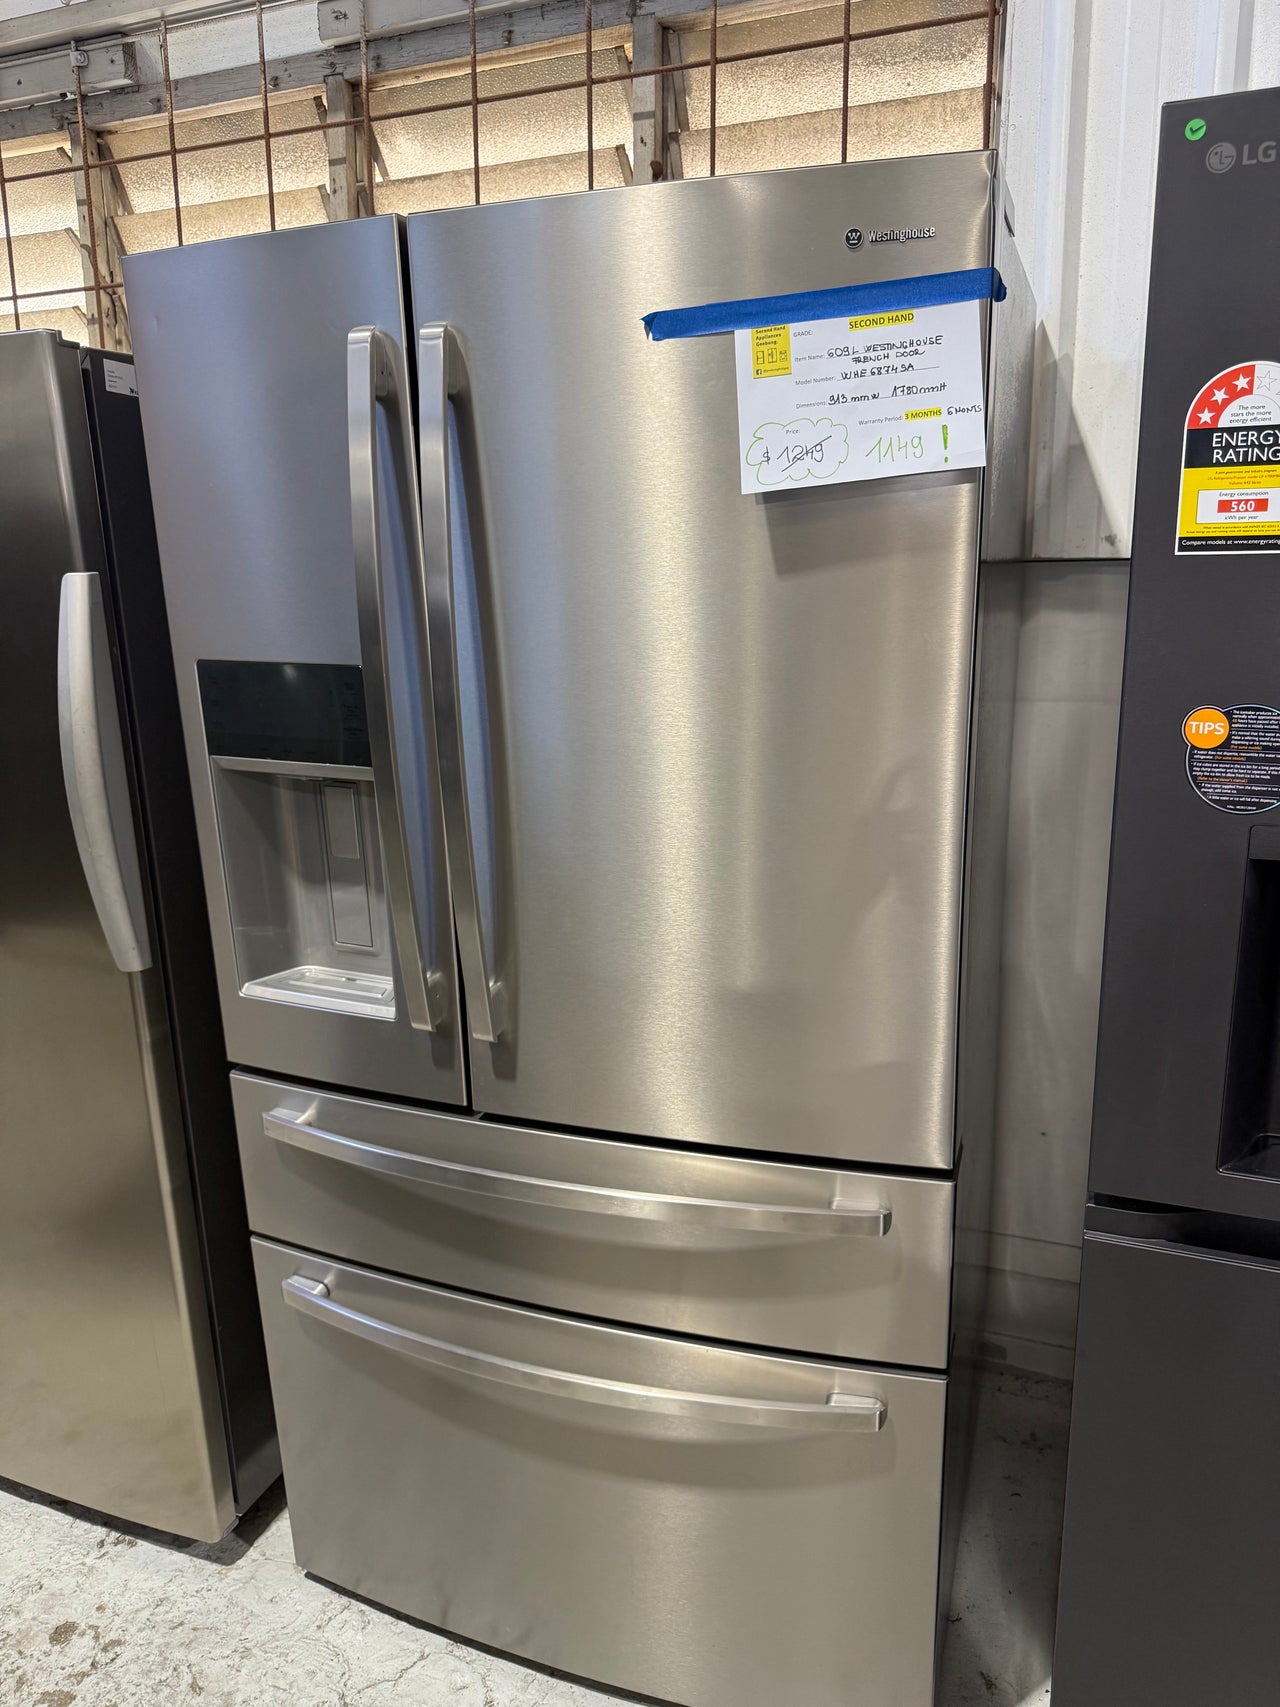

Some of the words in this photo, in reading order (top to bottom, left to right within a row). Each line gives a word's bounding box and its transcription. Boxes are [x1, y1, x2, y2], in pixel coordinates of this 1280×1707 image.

[1242, 141, 1277, 165] LG
[868, 227, 936, 242] Westinghouse
[849, 317, 885, 330] SECOND
[888, 312, 914, 324] HAND
[864, 335, 943, 352] WESTINGHOUSE
[896, 348, 926, 358] DOOR
[813, 376, 836, 384] Number:
[858, 418, 884, 426] Warranty
[910, 410, 942, 419] MONTHS
[947, 406, 954, 416] 6
[1212, 446, 1280, 464] RATING
[1230, 500, 1255, 512] 560
[1189, 722, 1224, 735] TIPS
